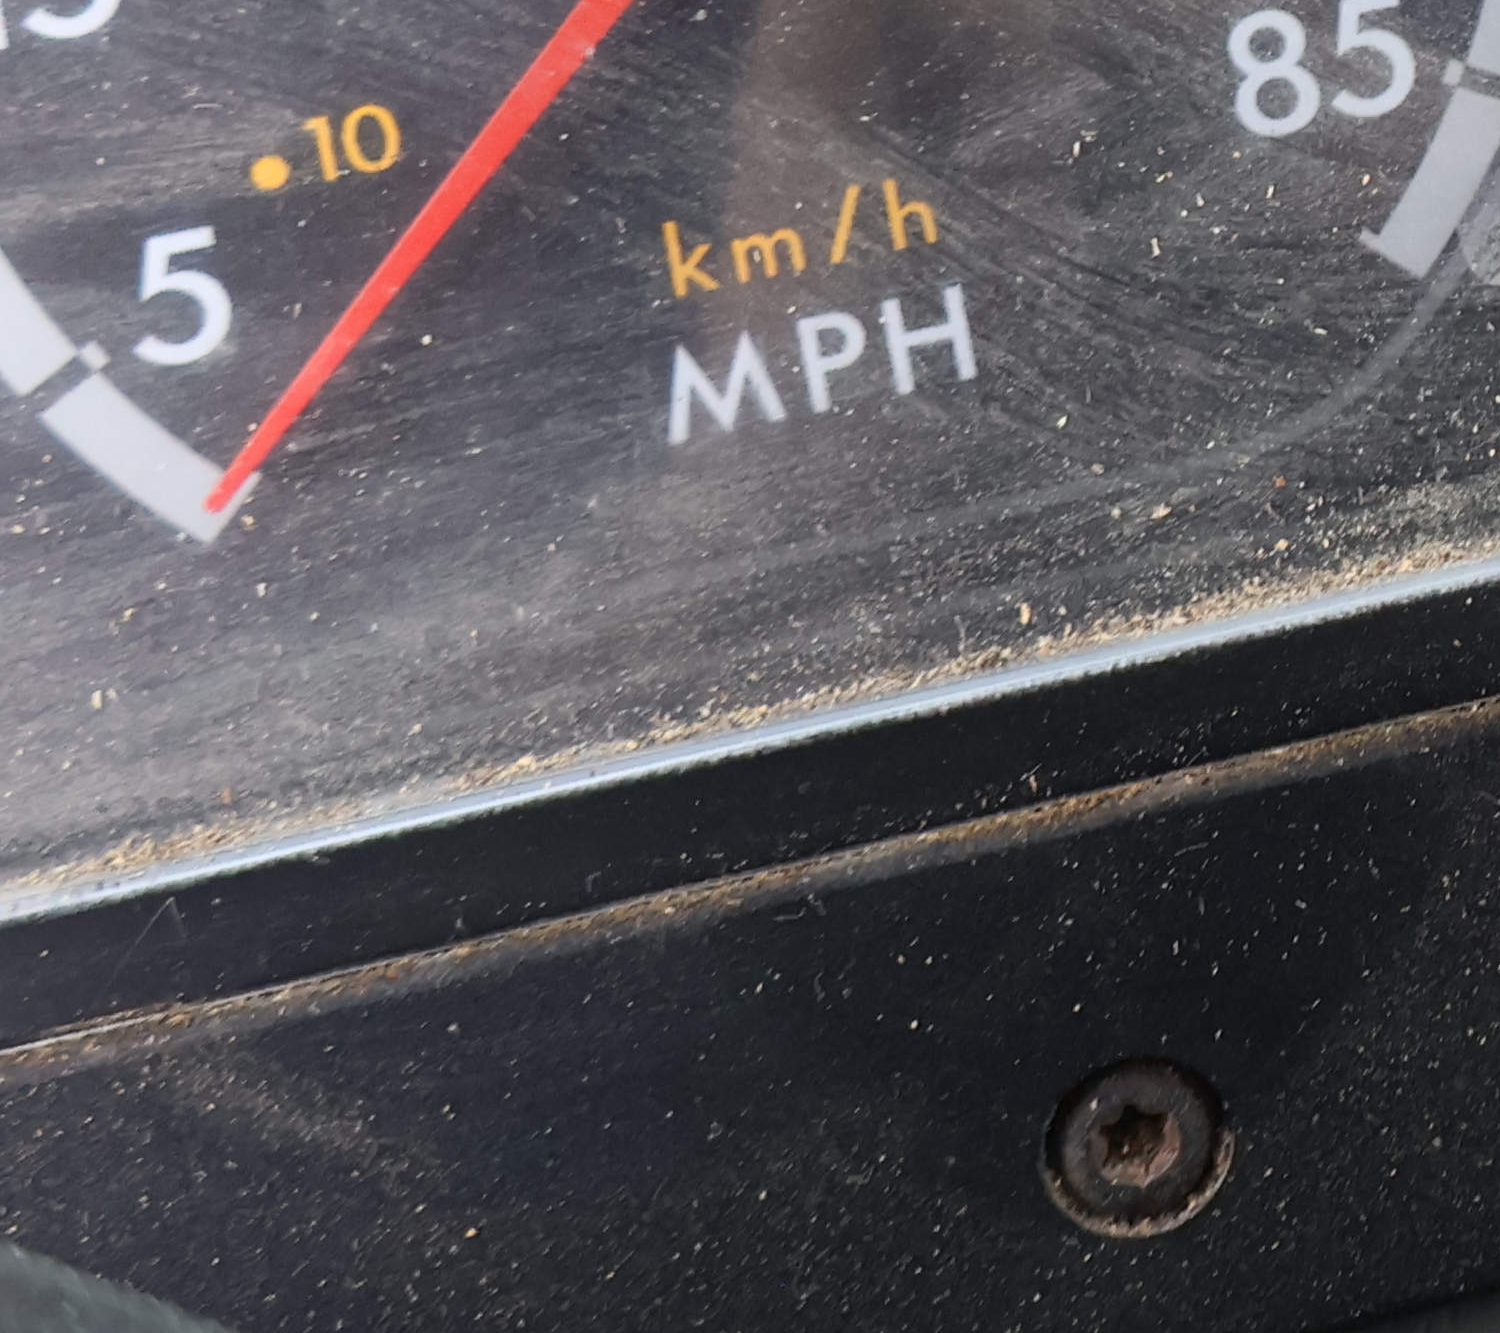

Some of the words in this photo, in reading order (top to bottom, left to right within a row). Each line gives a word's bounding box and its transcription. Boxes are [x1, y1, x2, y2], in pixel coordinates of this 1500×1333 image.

[302, 104, 401, 182] 10
[131, 226, 232, 366] 5
[662, 179, 937, 298] km/h
[667, 283, 979, 445] MPH
